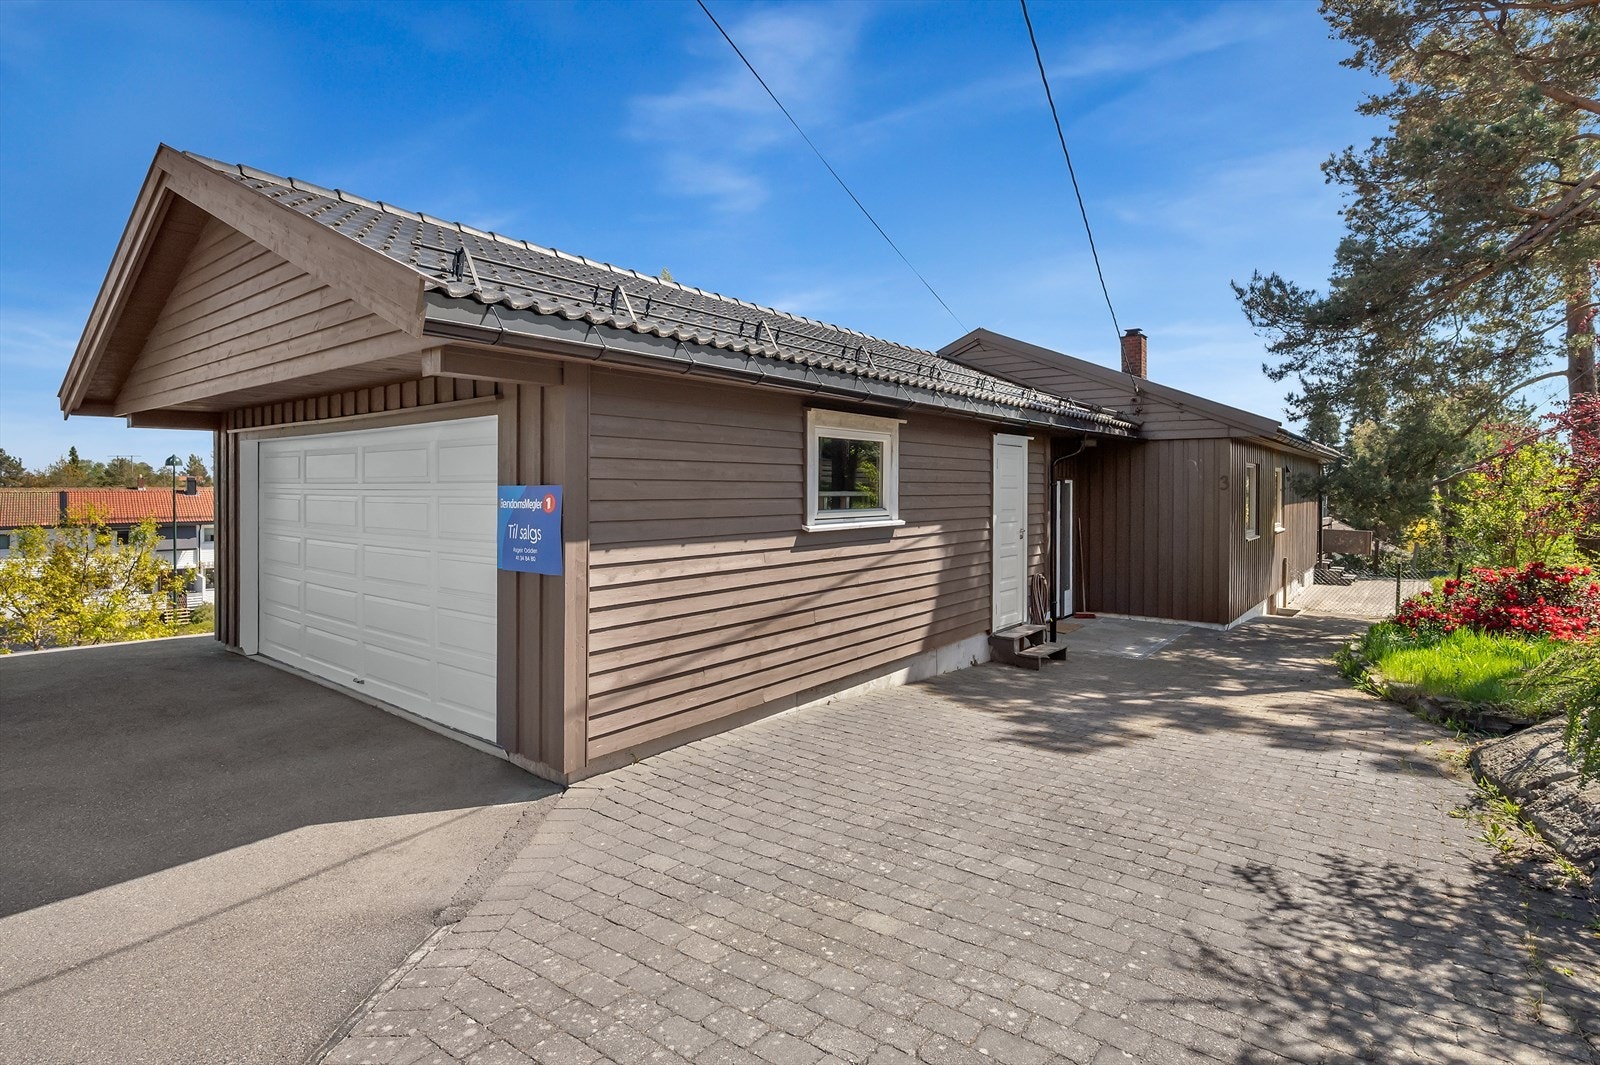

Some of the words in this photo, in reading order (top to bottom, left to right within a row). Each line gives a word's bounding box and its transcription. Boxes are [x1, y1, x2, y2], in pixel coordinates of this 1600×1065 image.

[1219, 475, 1229, 491] 3
[546, 498, 552, 510] 1
[508, 523, 519, 539] Til
[519, 524, 542, 544] salgs
